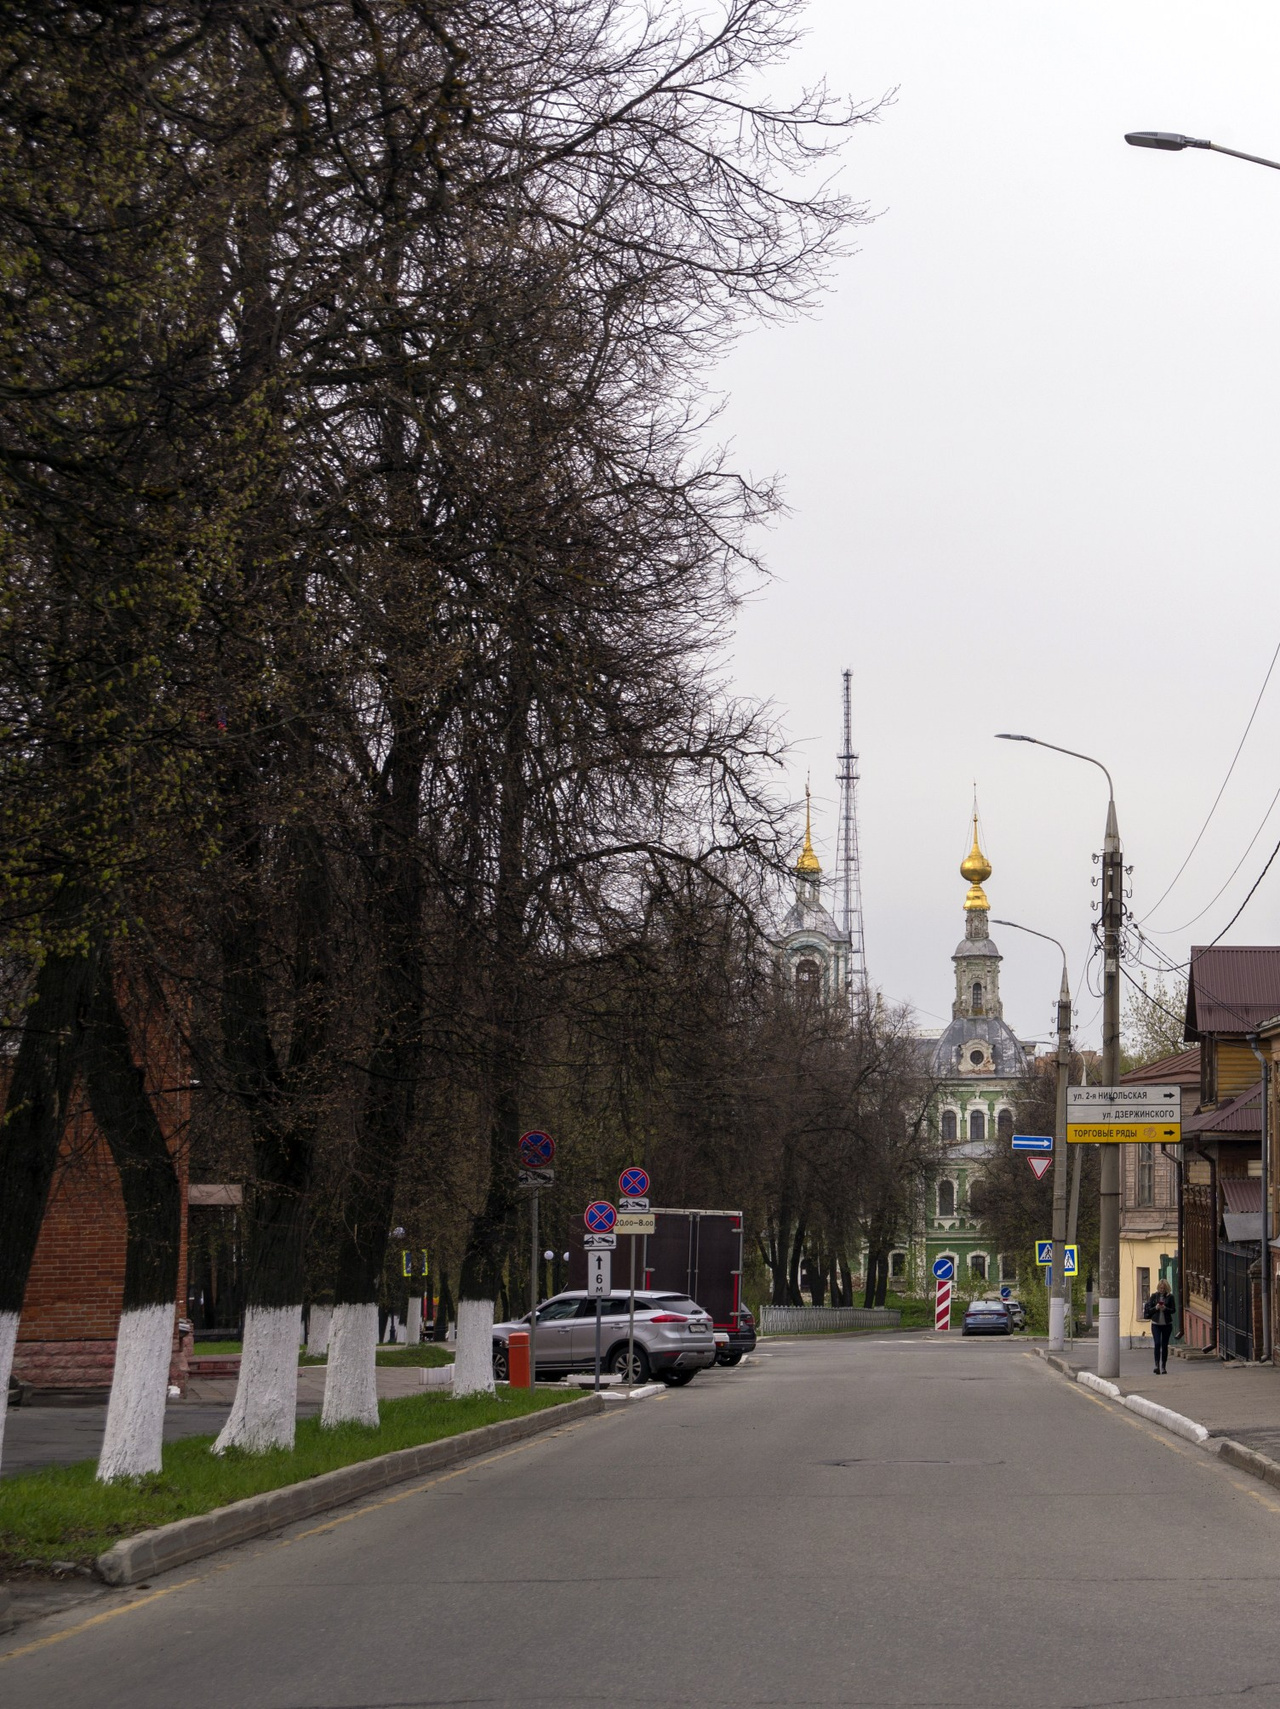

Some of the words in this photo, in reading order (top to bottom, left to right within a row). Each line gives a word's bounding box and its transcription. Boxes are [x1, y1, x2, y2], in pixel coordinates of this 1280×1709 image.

[1073, 1093, 1084, 1101] ул.
[1086, 1092, 1096, 1100] 2-я
[1098, 1091, 1148, 1100] НИКОЛЬСКАЯ
[1102, 1112, 1113, 1120] ул.
[1114, 1110, 1175, 1119] ДЗЕРЖИНСКОГО
[1073, 1129, 1114, 1138] ТОРГОВЫЕ
[1116, 1129, 1137, 1138] РЯДЫ
[596, 1274, 603, 1284] 6
